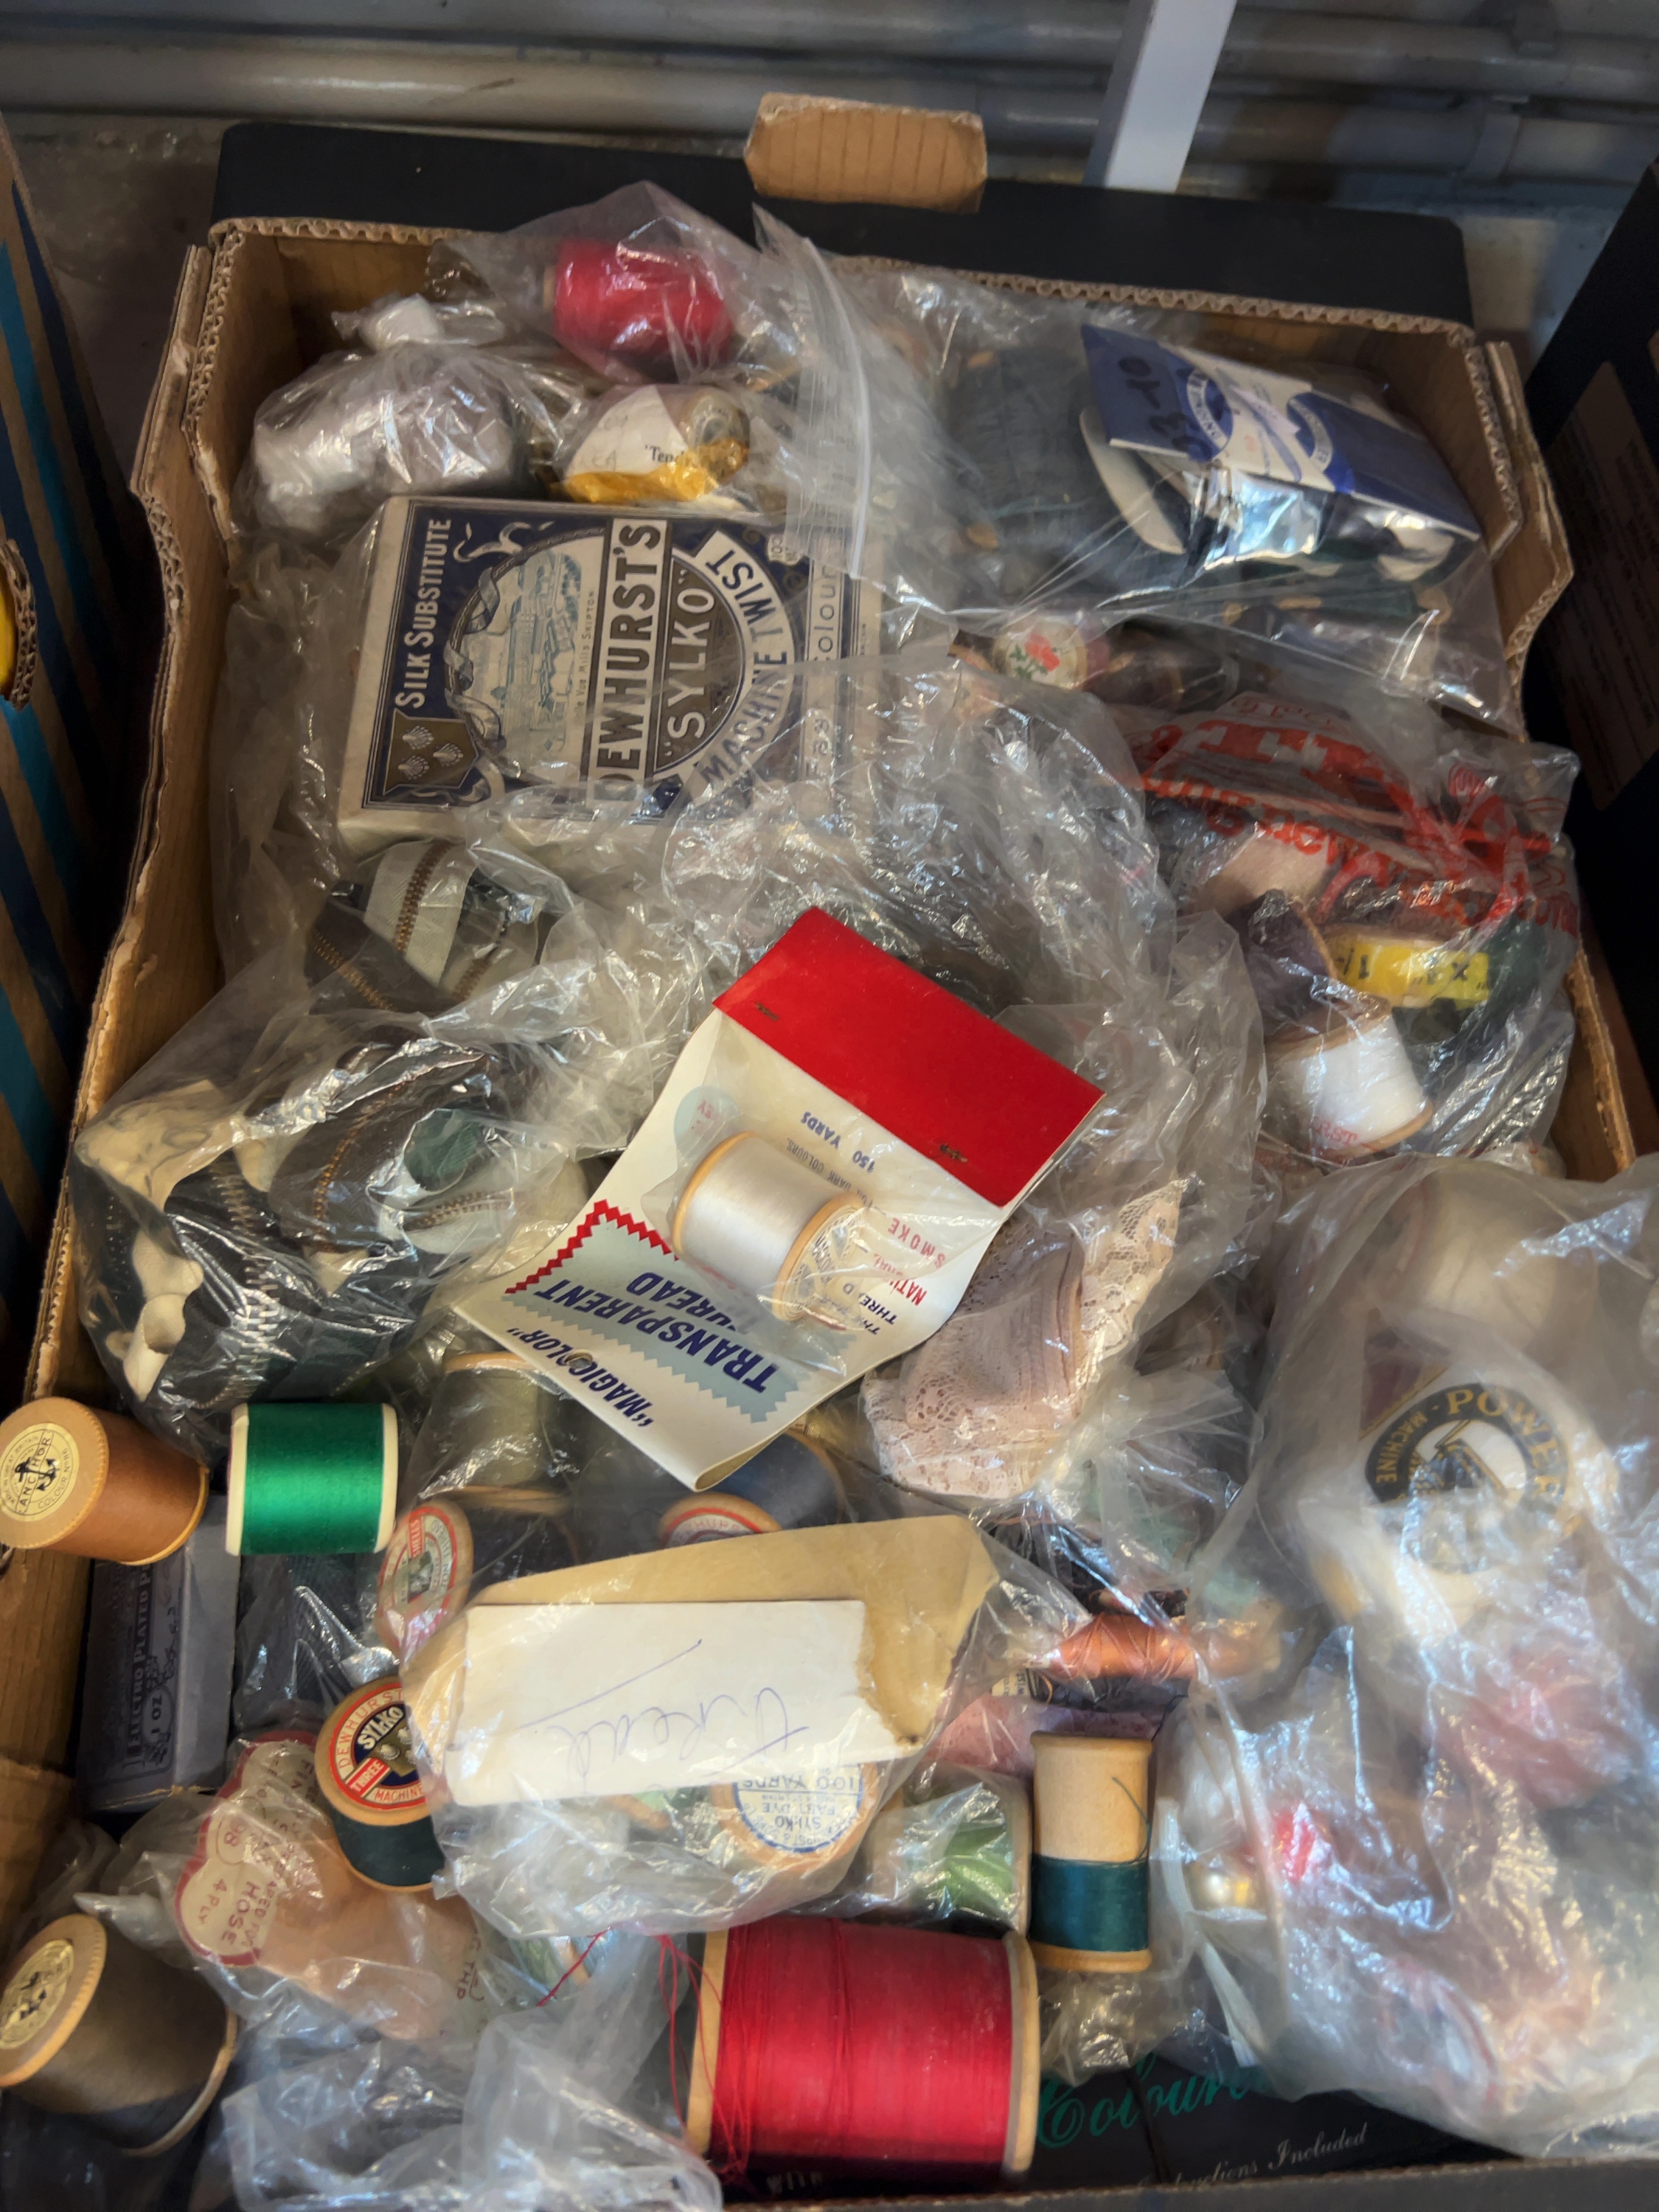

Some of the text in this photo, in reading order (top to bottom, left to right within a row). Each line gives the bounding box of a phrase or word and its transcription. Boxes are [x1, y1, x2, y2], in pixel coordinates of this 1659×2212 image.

[394, 518, 452, 709] SILK SUBSTITUTE
[700, 547, 789, 786] MACHINE TWIST
[799, 1110, 843, 1150] YARDS
[786, 1136, 827, 1175] COLOURS.
[851, 1150, 877, 1174] 150
[826, 1167, 852, 1194] DARK
[887, 1215, 947, 1270] SMOKE
[842, 1281, 898, 1326] THREAD
[871, 1252, 928, 1307] NATURAL
[535, 1278, 782, 1393] TRANSPARENT
[1375, 1410, 1430, 1484] MACHINE
[19, 1436, 52, 1507] ANCHOR
[38, 1476, 69, 1509] COLOUR
[133, 1591, 149, 1665] PLATED
[150, 1694, 163, 1721] OZ
[335, 1691, 402, 1769] DEWHURST
[349, 1760, 385, 1792] THREE
[374, 1787, 423, 1803] MACHINE
[742, 1775, 855, 1792] 100 YARDS
[760, 1802, 836, 1815] FAST DYE
[198, 1877, 228, 1925] 4 PLY
[220, 1881, 261, 1946] HOSE
[1267, 2121, 1369, 2171] Included
